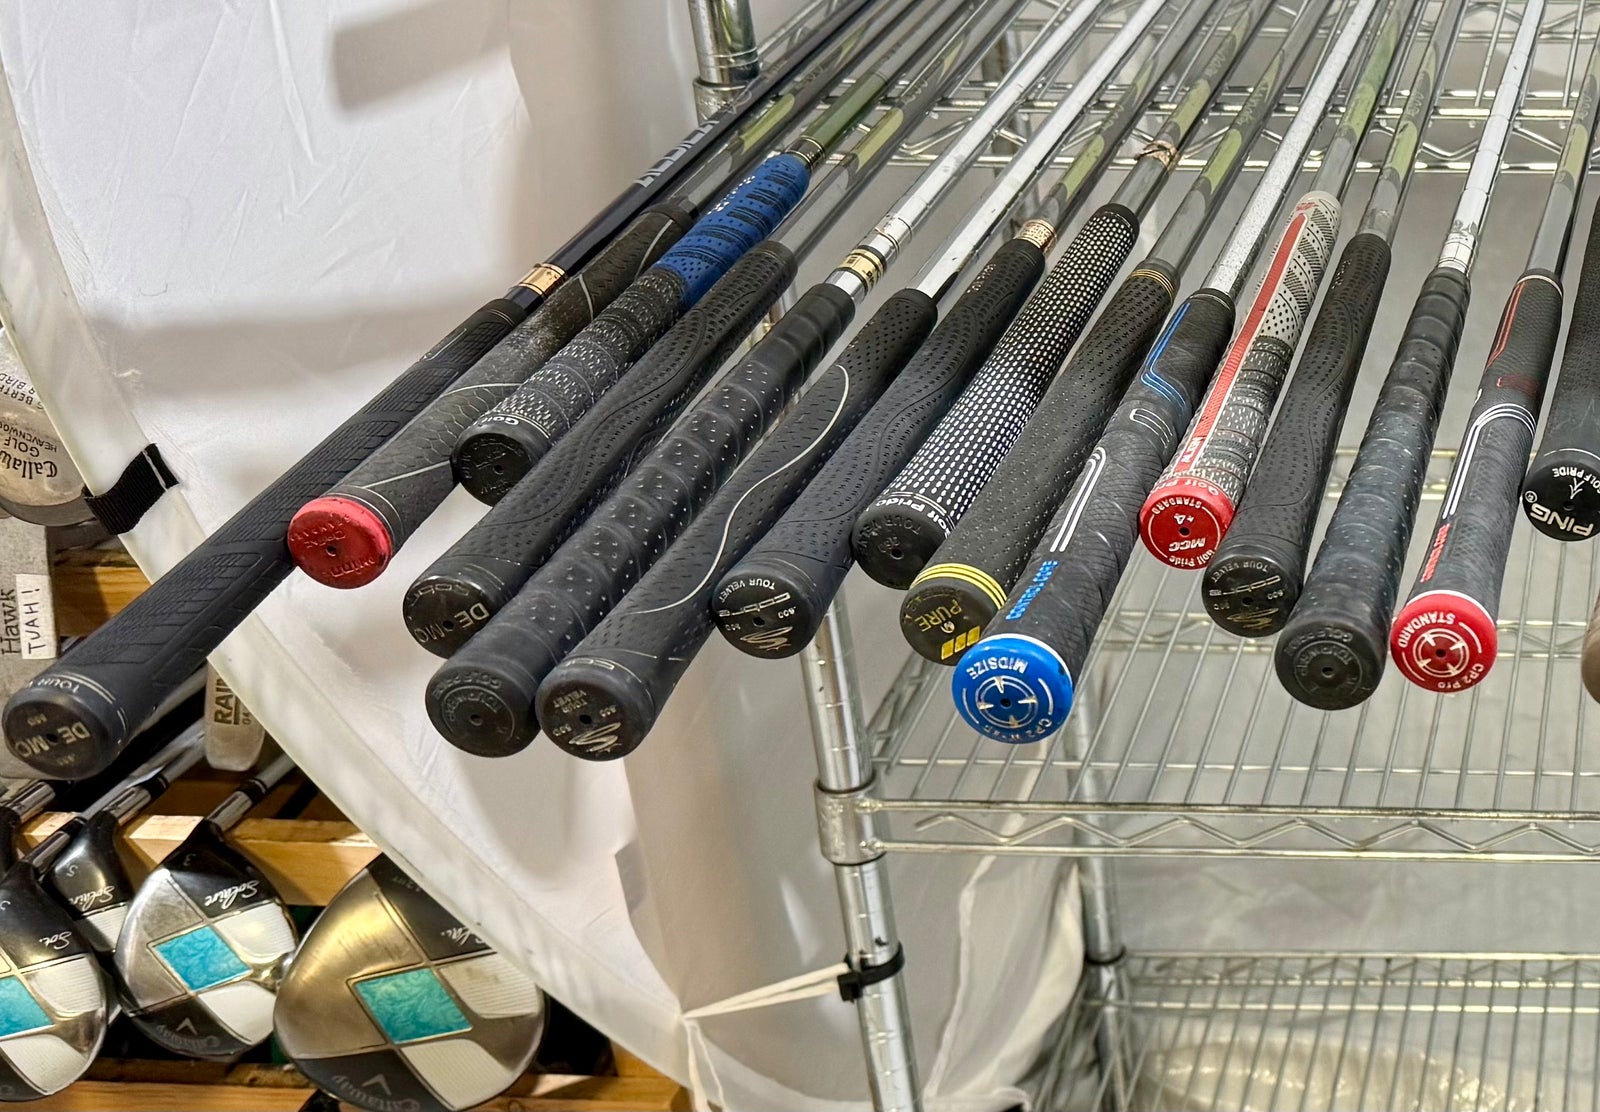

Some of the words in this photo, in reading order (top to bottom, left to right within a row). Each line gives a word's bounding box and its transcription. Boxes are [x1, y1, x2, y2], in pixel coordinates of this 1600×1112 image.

[4, 437, 40, 457] GOLF
[1552, 466, 1584, 478] PRIDE
[875, 497, 926, 512] Pride
[1151, 497, 1202, 515] STANDARD
[1530, 503, 1594, 537] PING
[1169, 537, 1206, 552] MCC
[1169, 555, 1195, 567] Pride
[718, 580, 746, 604] VELVET
[751, 578, 776, 591] TOUR
[0, 588, 22, 656] Hawk
[914, 599, 963, 633] PURE
[1397, 611, 1456, 649] STANDARD
[966, 656, 1028, 680] MIDSIZE
